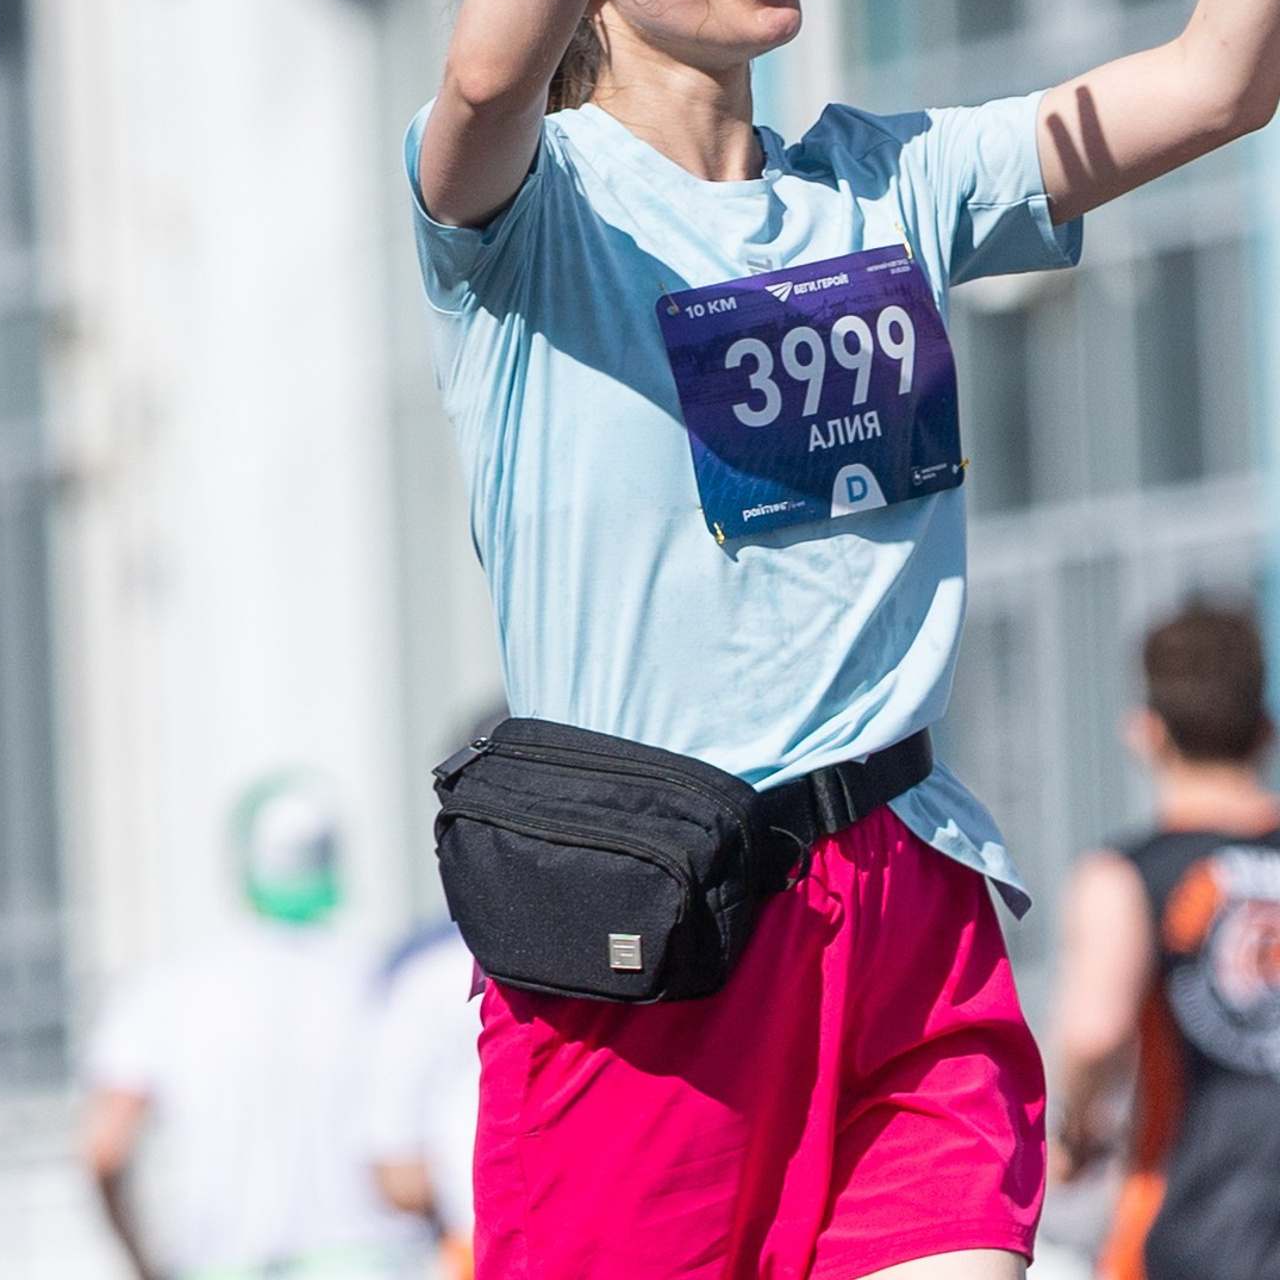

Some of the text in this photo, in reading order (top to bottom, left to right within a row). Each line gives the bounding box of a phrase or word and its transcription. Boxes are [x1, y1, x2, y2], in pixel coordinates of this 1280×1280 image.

[685, 306, 705, 319] 10
[724, 305, 916, 428] 3999
[808, 410, 882, 453] АЛИЯ
[846, 475, 869, 503] D
